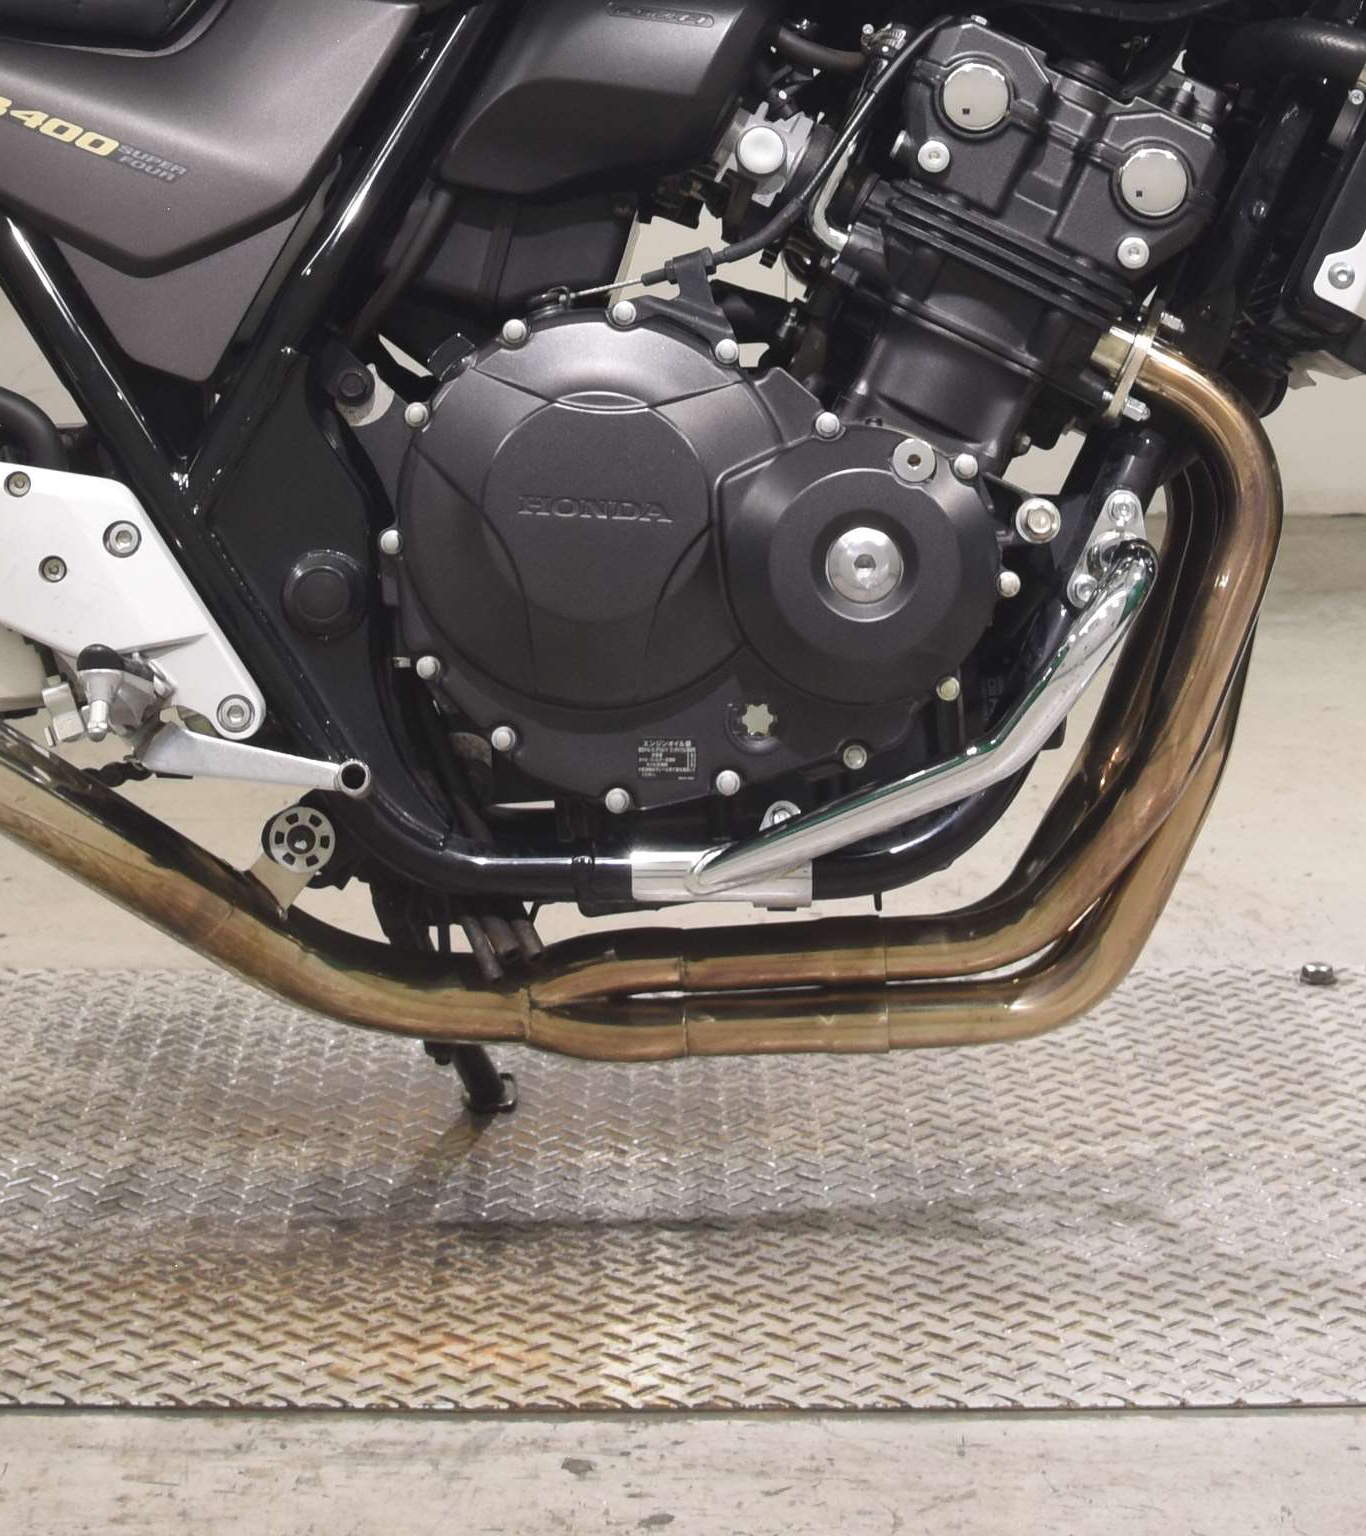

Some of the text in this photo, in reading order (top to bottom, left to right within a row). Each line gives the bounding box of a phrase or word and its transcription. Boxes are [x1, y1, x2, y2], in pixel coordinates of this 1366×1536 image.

[118, 144, 187, 175] SUPER
[119, 155, 176, 181] FOUR
[517, 495, 674, 524] HONDA
